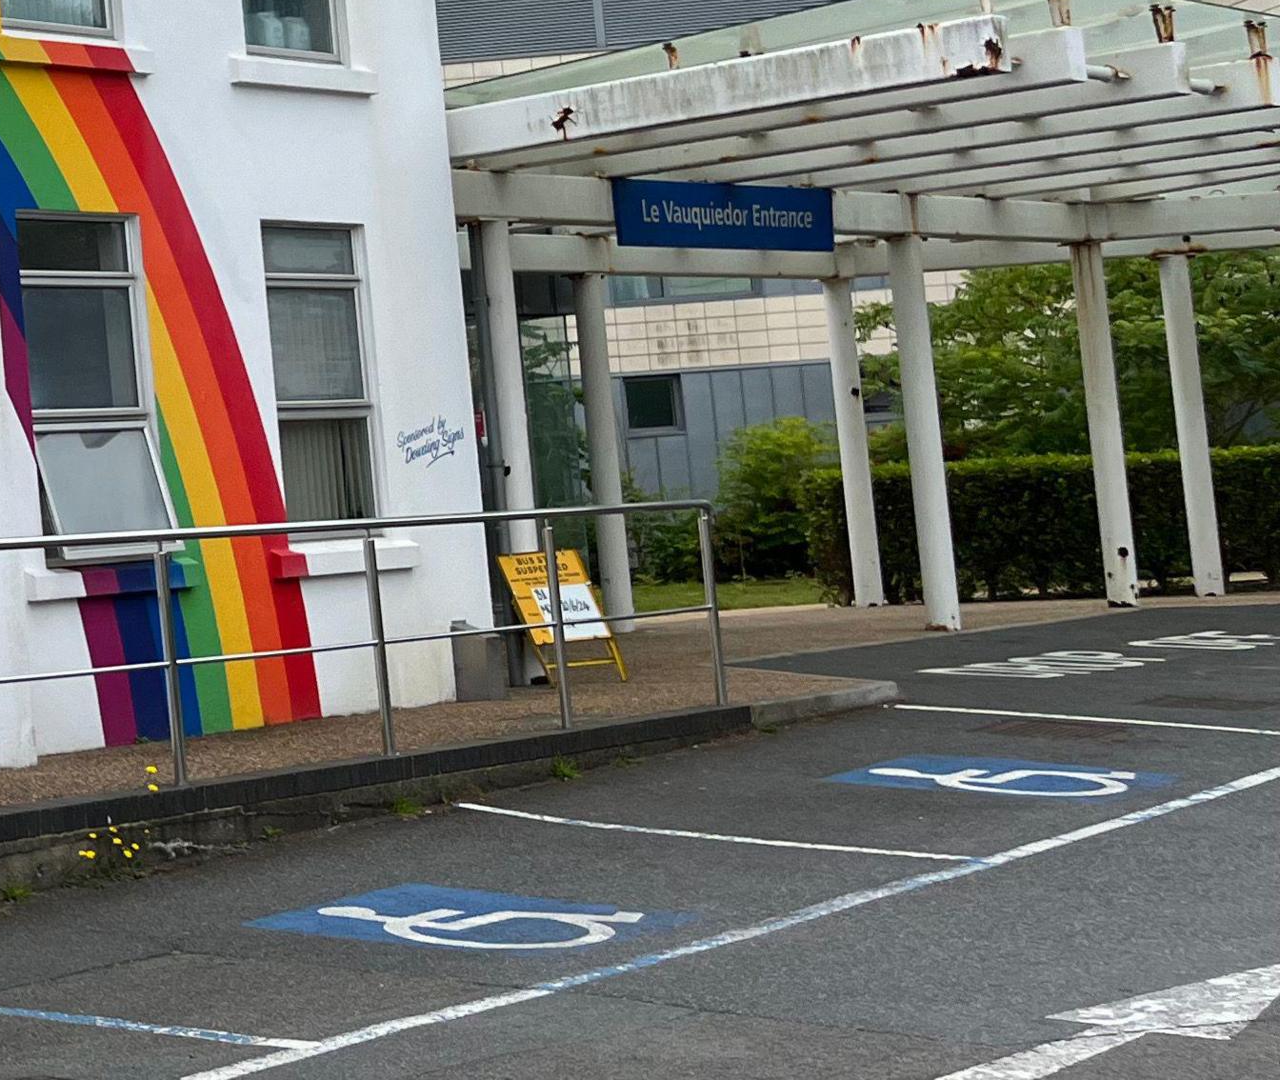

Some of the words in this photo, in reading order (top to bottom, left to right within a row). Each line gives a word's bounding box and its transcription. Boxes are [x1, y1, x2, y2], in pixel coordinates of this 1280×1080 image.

[641, 198, 660, 223] Le
[662, 200, 748, 231] Vauquiedor
[752, 204, 814, 229] Entrance
[437, 414, 447, 435] by
[441, 427, 465, 451] Signs
[915, 649, 1167, 679] DROP
